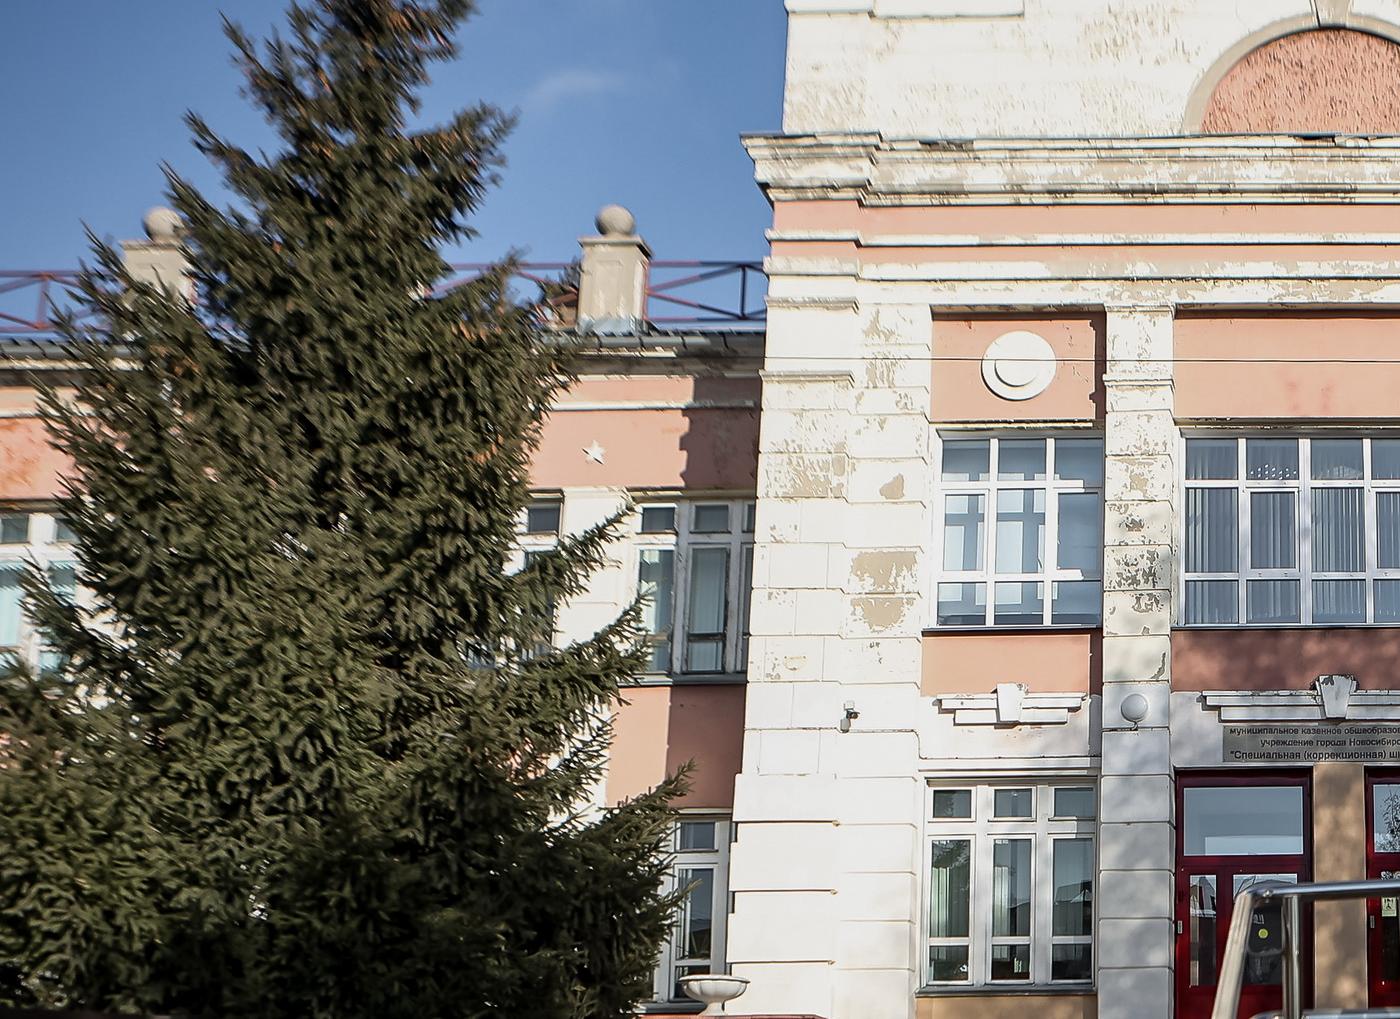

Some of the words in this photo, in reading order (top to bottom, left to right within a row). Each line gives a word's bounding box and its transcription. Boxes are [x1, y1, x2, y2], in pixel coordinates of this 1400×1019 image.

[1229, 727, 1299, 736] муниципальное
[1301, 727, 1342, 735] казенное
[1260, 739, 1313, 747] учреждение
[1316, 739, 1346, 747] города
[1303, 750, 1387, 760] (коррекционная)
